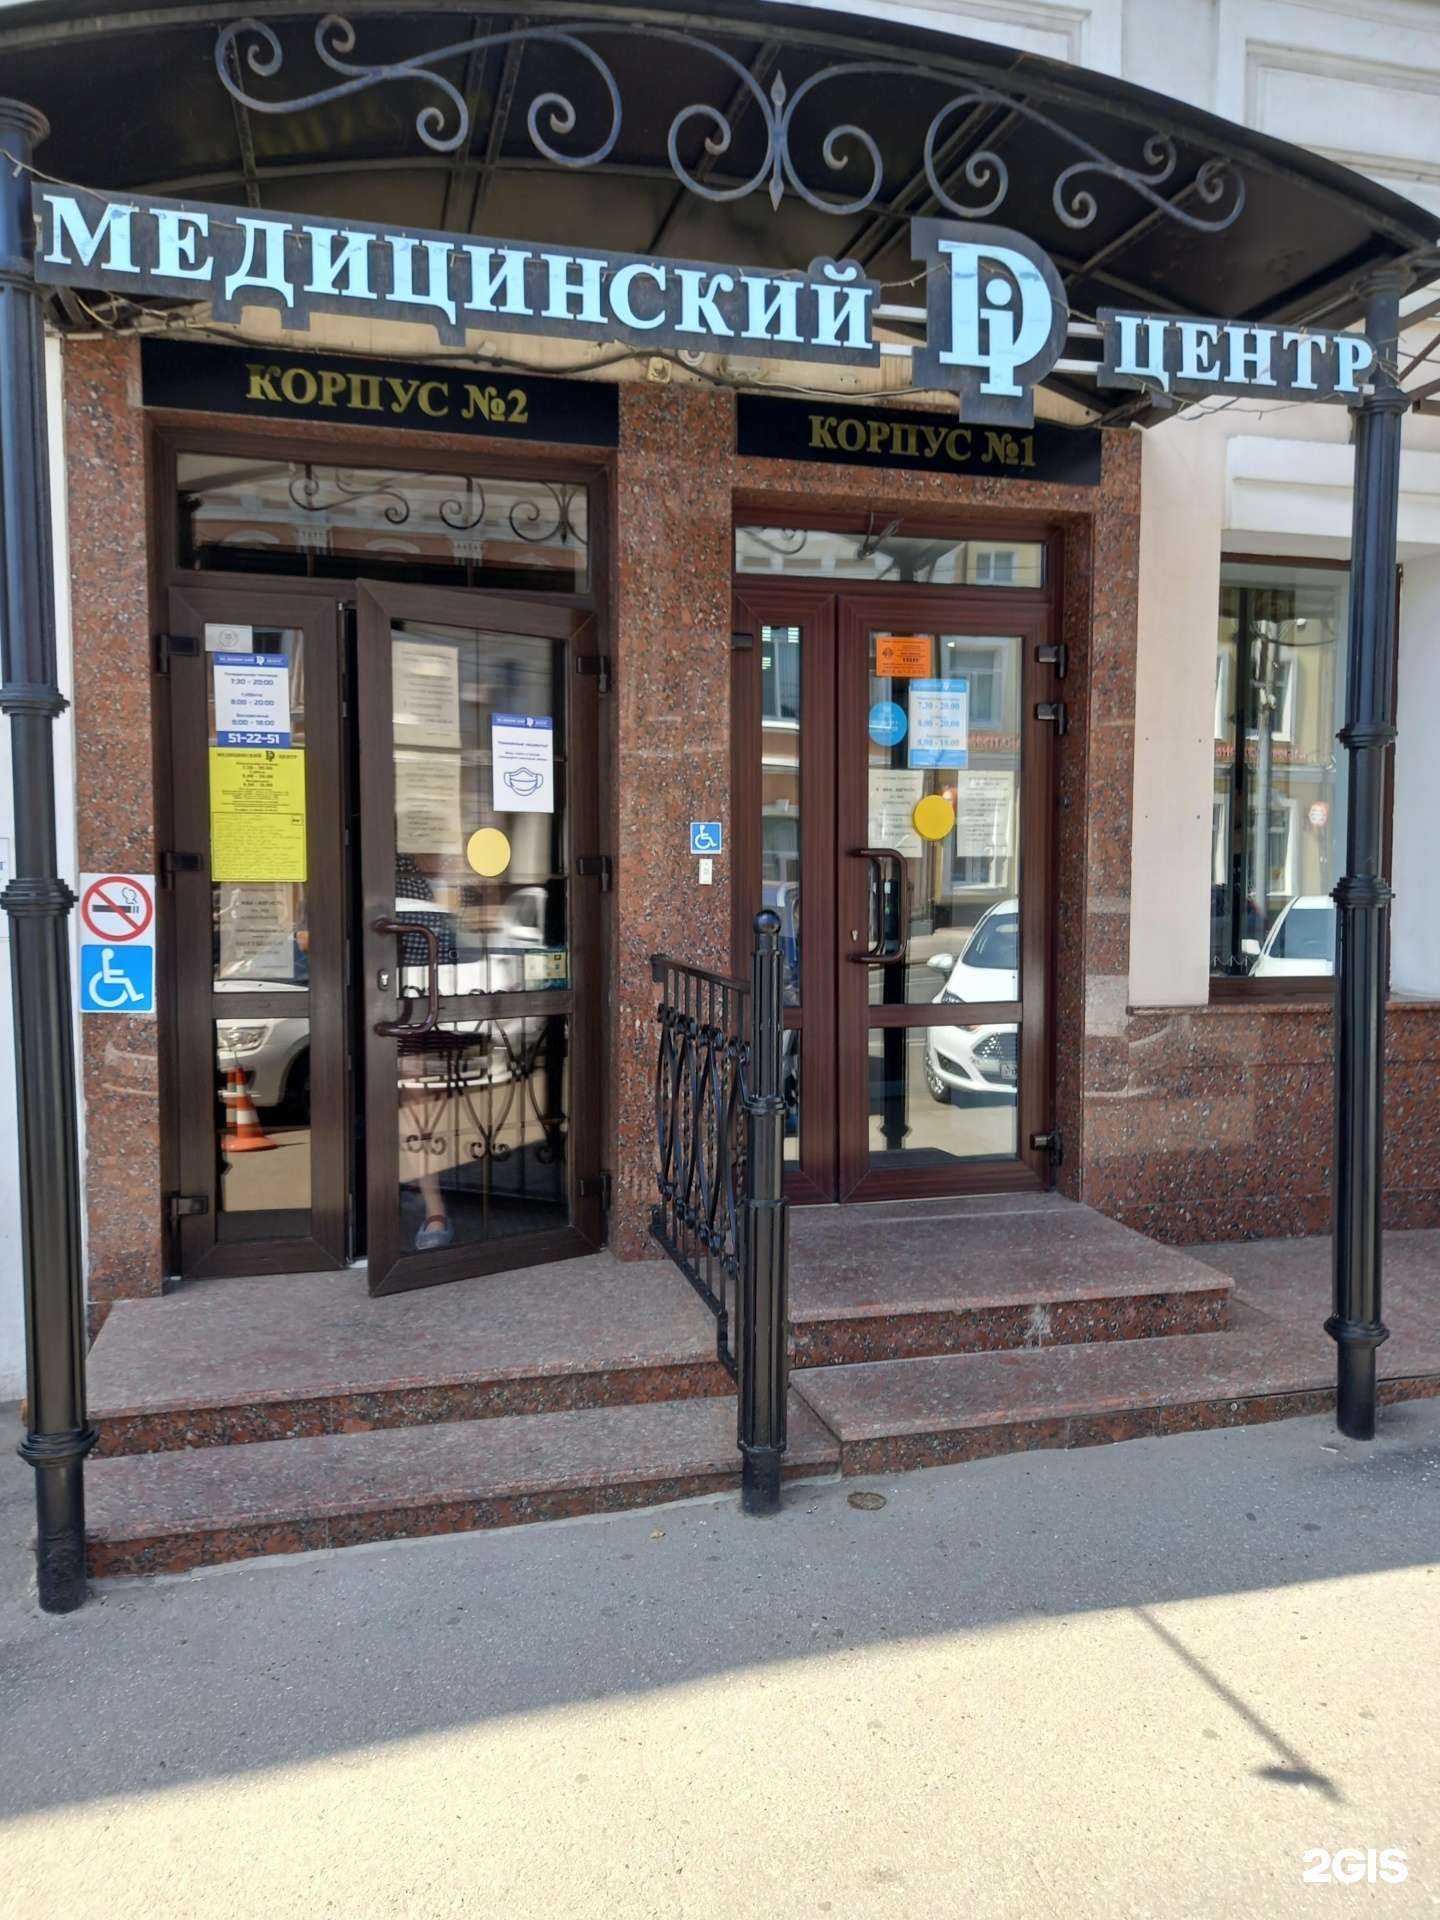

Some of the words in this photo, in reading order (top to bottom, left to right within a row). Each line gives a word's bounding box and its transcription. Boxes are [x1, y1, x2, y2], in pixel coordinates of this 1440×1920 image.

[43, 194, 872, 350] МЕДИЦИНСКИЙ
[1115, 315, 1374, 394] ЦЕНТР
[245, 363, 449, 418] КОРПУС
[461, 384, 529, 424] №2
[808, 415, 972, 462] КОРПУС
[980, 431, 1036, 467] №1
[228, 732, 280, 745] 51-22-51
